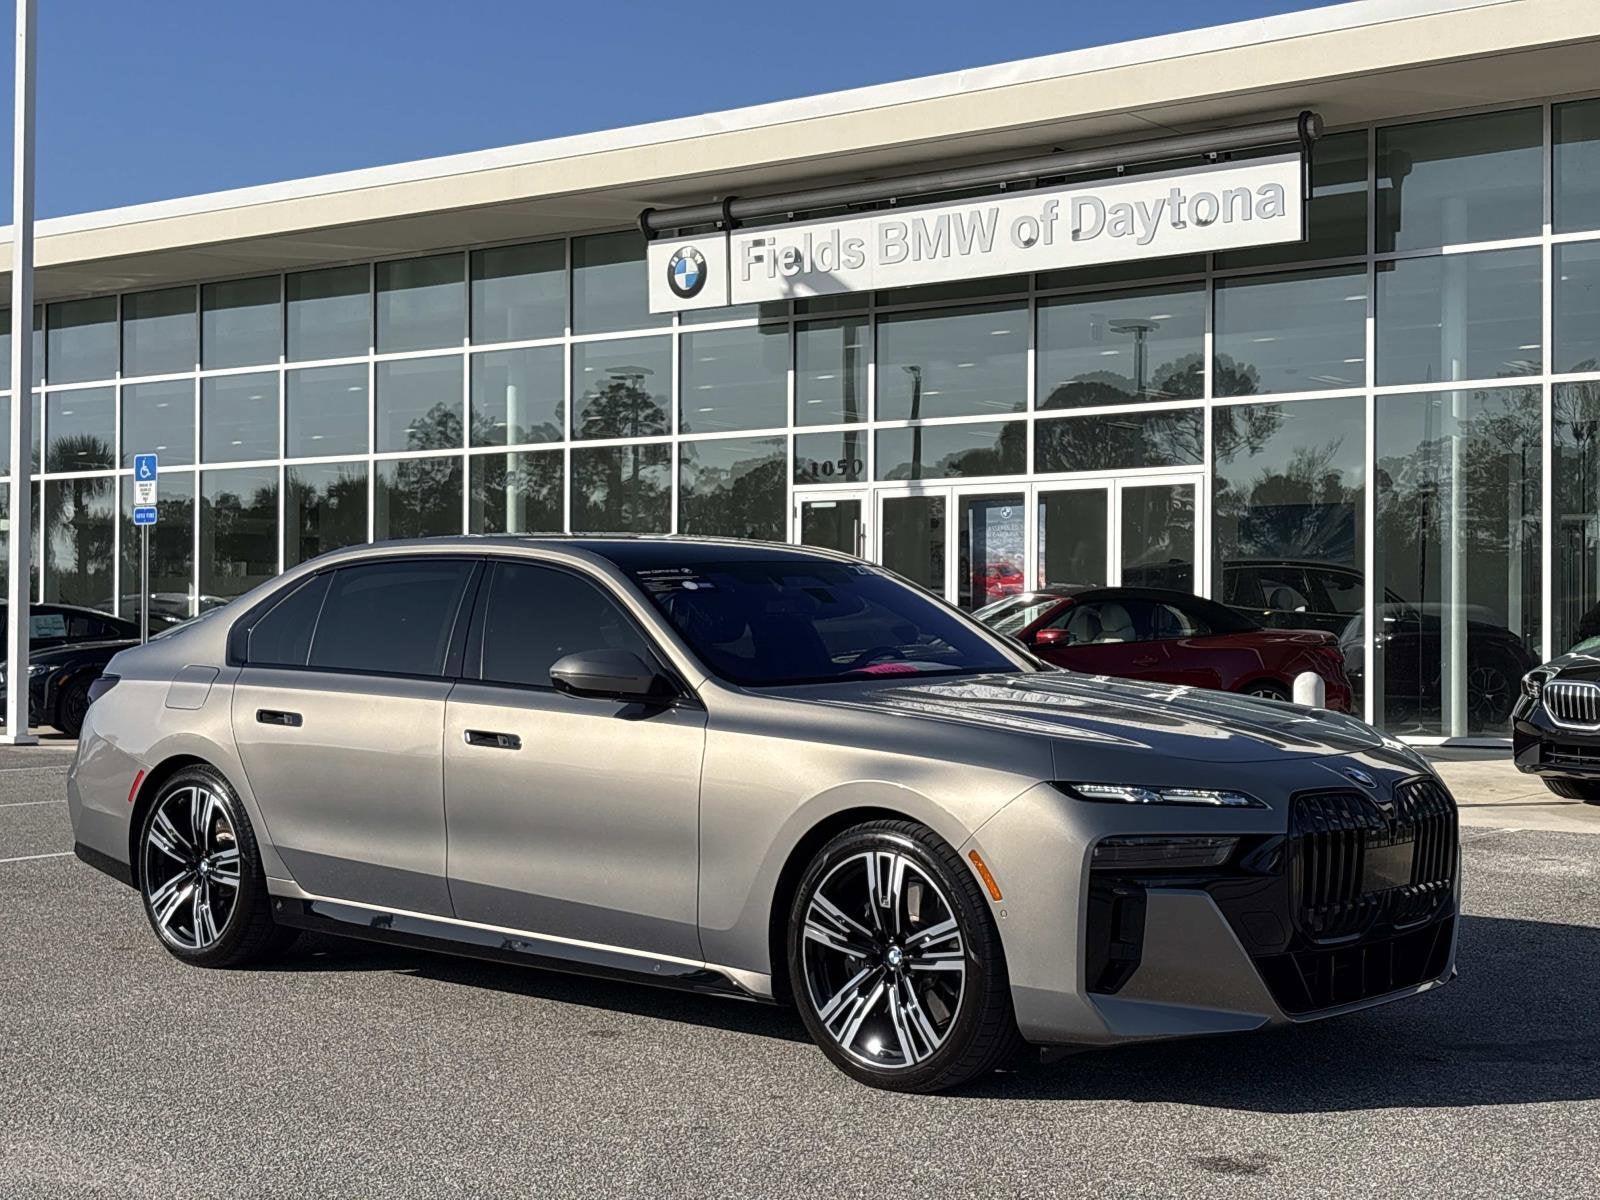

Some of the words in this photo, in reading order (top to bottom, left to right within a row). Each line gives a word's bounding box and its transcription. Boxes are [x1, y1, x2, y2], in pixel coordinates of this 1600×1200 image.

[741, 228, 865, 281] Fields
[878, 207, 999, 265] BMW
[1010, 200, 1059, 249] of
[1071, 182, 1286, 246] Daytona
[810, 459, 863, 477] 1050
